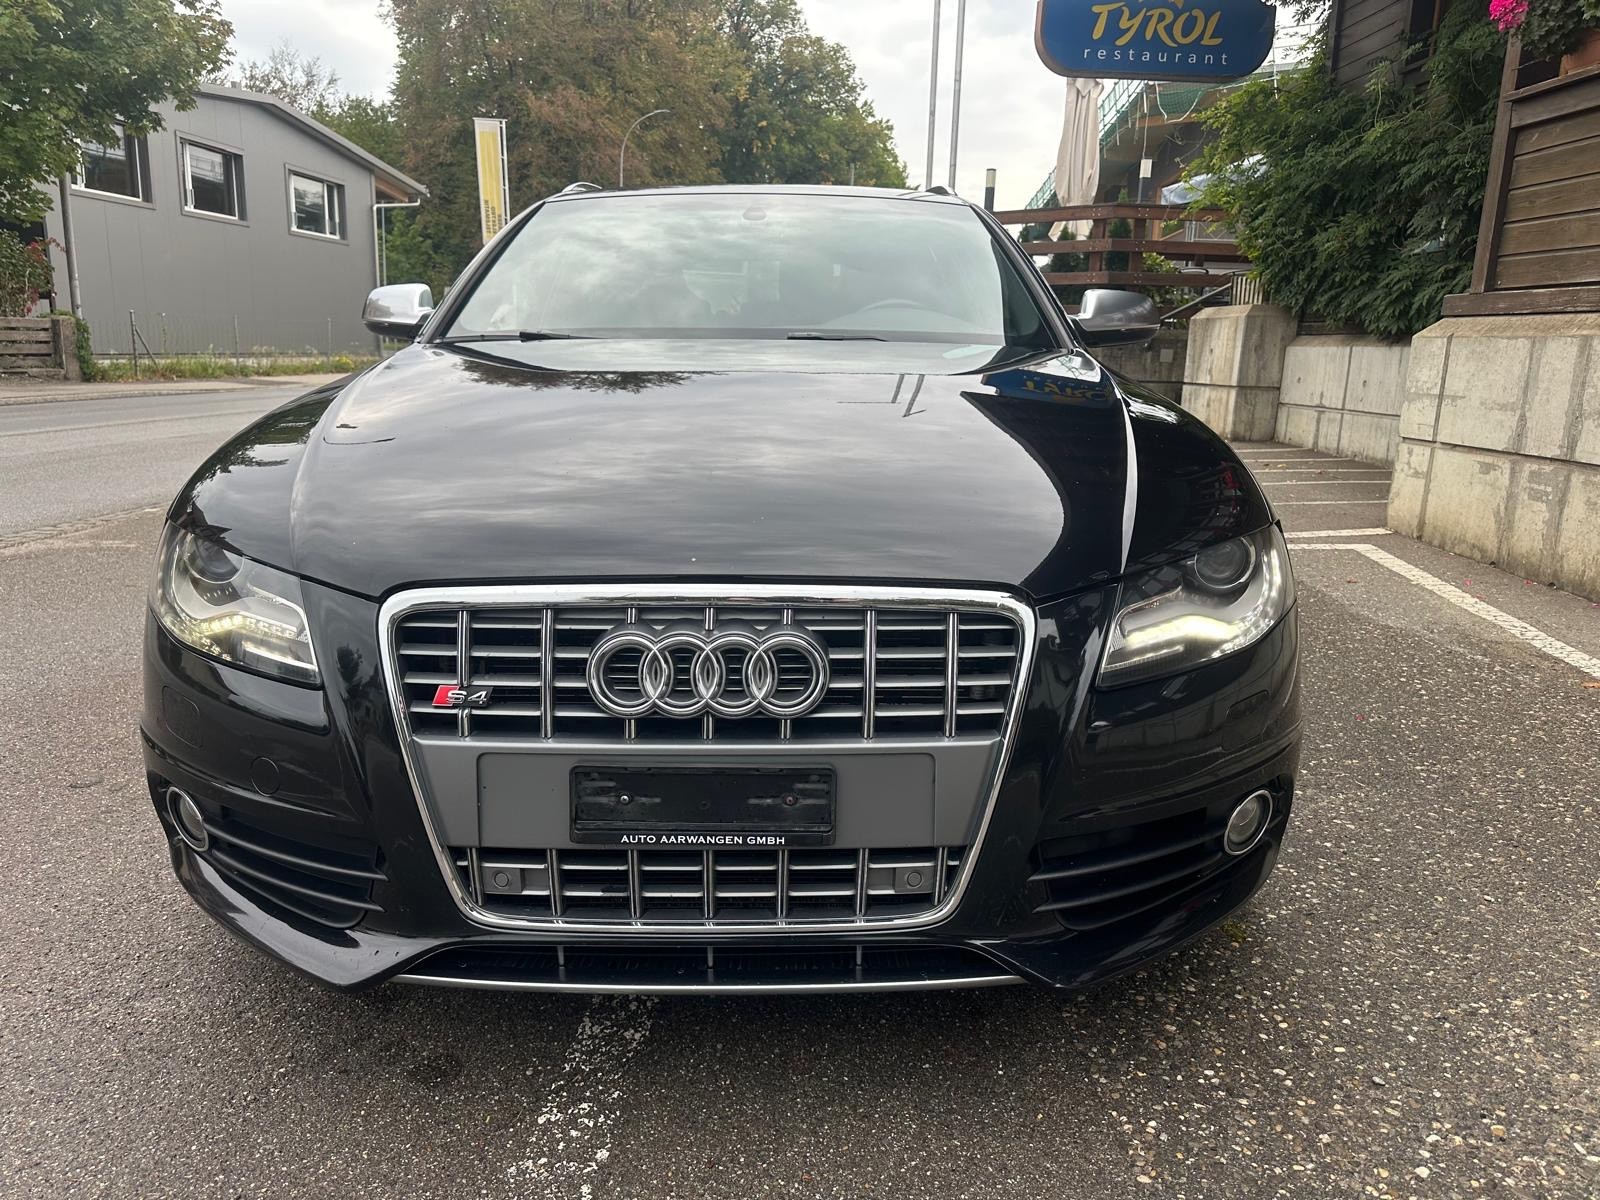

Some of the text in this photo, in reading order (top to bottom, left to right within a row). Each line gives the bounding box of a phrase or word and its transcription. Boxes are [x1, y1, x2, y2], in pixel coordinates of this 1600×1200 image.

[1091, 2, 1223, 47] TYROL
[1083, 48, 1227, 65] restaurant
[446, 690, 487, 704] S4
[620, 834, 785, 846] AUTO AARWANGEN GMBH
